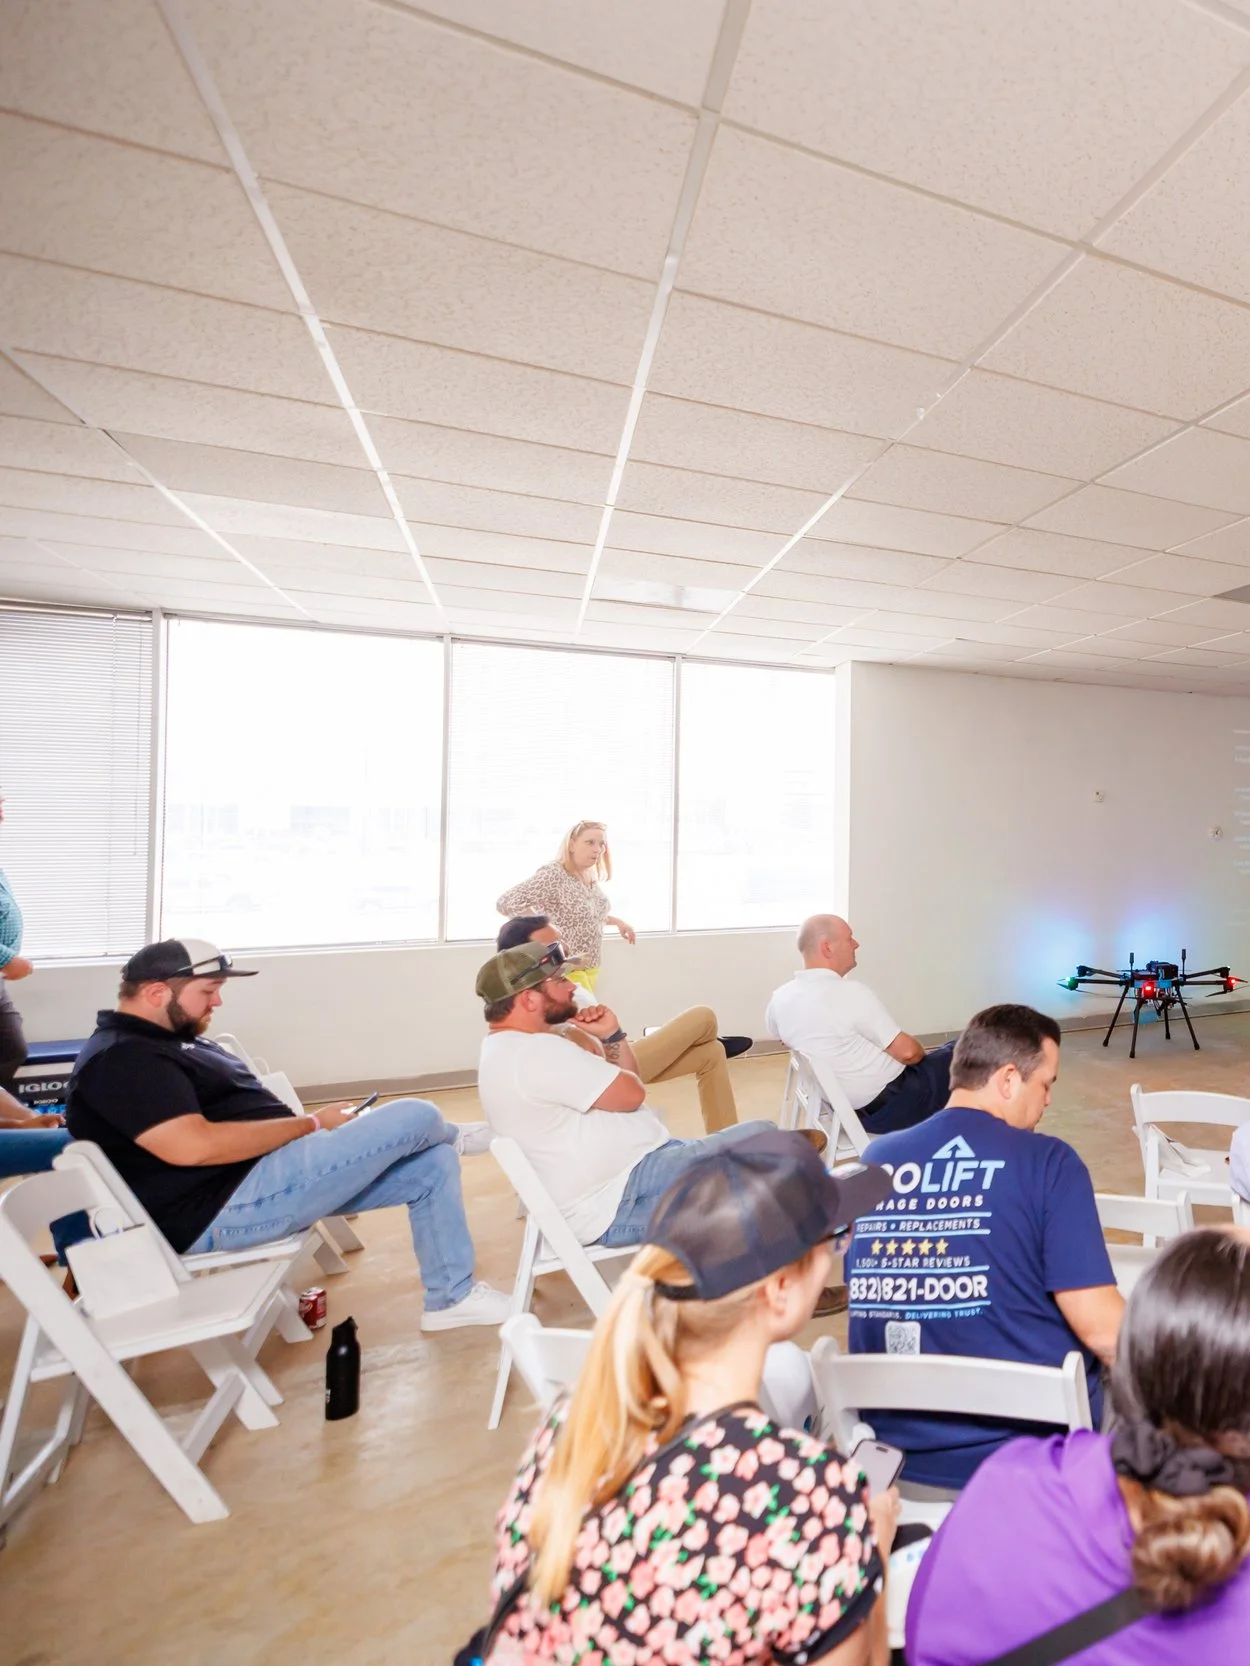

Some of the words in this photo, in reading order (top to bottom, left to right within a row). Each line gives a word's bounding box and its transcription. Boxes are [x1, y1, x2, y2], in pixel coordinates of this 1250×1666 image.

[880, 1160, 1005, 1194] OLIFT
[875, 1197, 918, 1211] RAGE
[926, 1194, 984, 1210] DOORS
[856, 1221, 887, 1232] REPAIRS
[899, 1218, 980, 1231] REPLACEMENTS
[881, 1256, 920, 1268] 5-STAR
[923, 1255, 971, 1268] REVIEWS
[849, 1274, 988, 1302] 832)821-DOOR
[905, 1310, 952, 1320] DELIVERING
[954, 1307, 983, 1318] TRUST.
